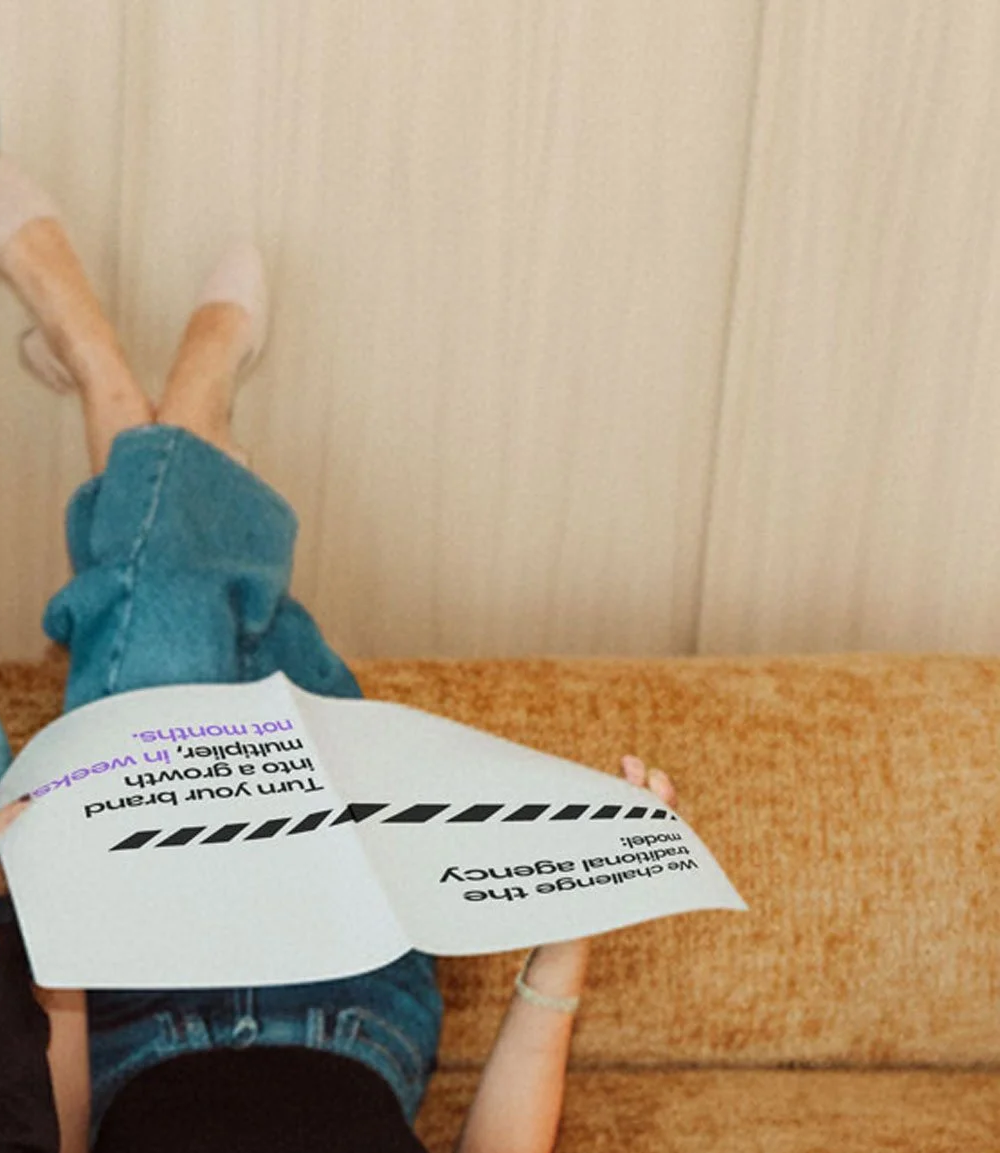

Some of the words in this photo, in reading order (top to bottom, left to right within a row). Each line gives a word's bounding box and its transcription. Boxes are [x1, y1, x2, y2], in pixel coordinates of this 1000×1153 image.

[132, 723, 248, 743] months.
[252, 718, 294, 736] not
[143, 749, 171, 764] in
[177, 738, 304, 760] multiplier,
[124, 762, 233, 789] growth
[238, 764, 256, 776] a
[262, 758, 315, 777] into
[185, 783, 252, 803] your
[257, 777, 324, 795] Turn
[84, 791, 177, 818] brand
[620, 832, 682, 849] model:
[582, 846, 690, 872] traditional
[668, 859, 698, 872] We
[439, 860, 576, 883] agency
[536, 866, 664, 895] challenge
[463, 886, 528, 902] the
